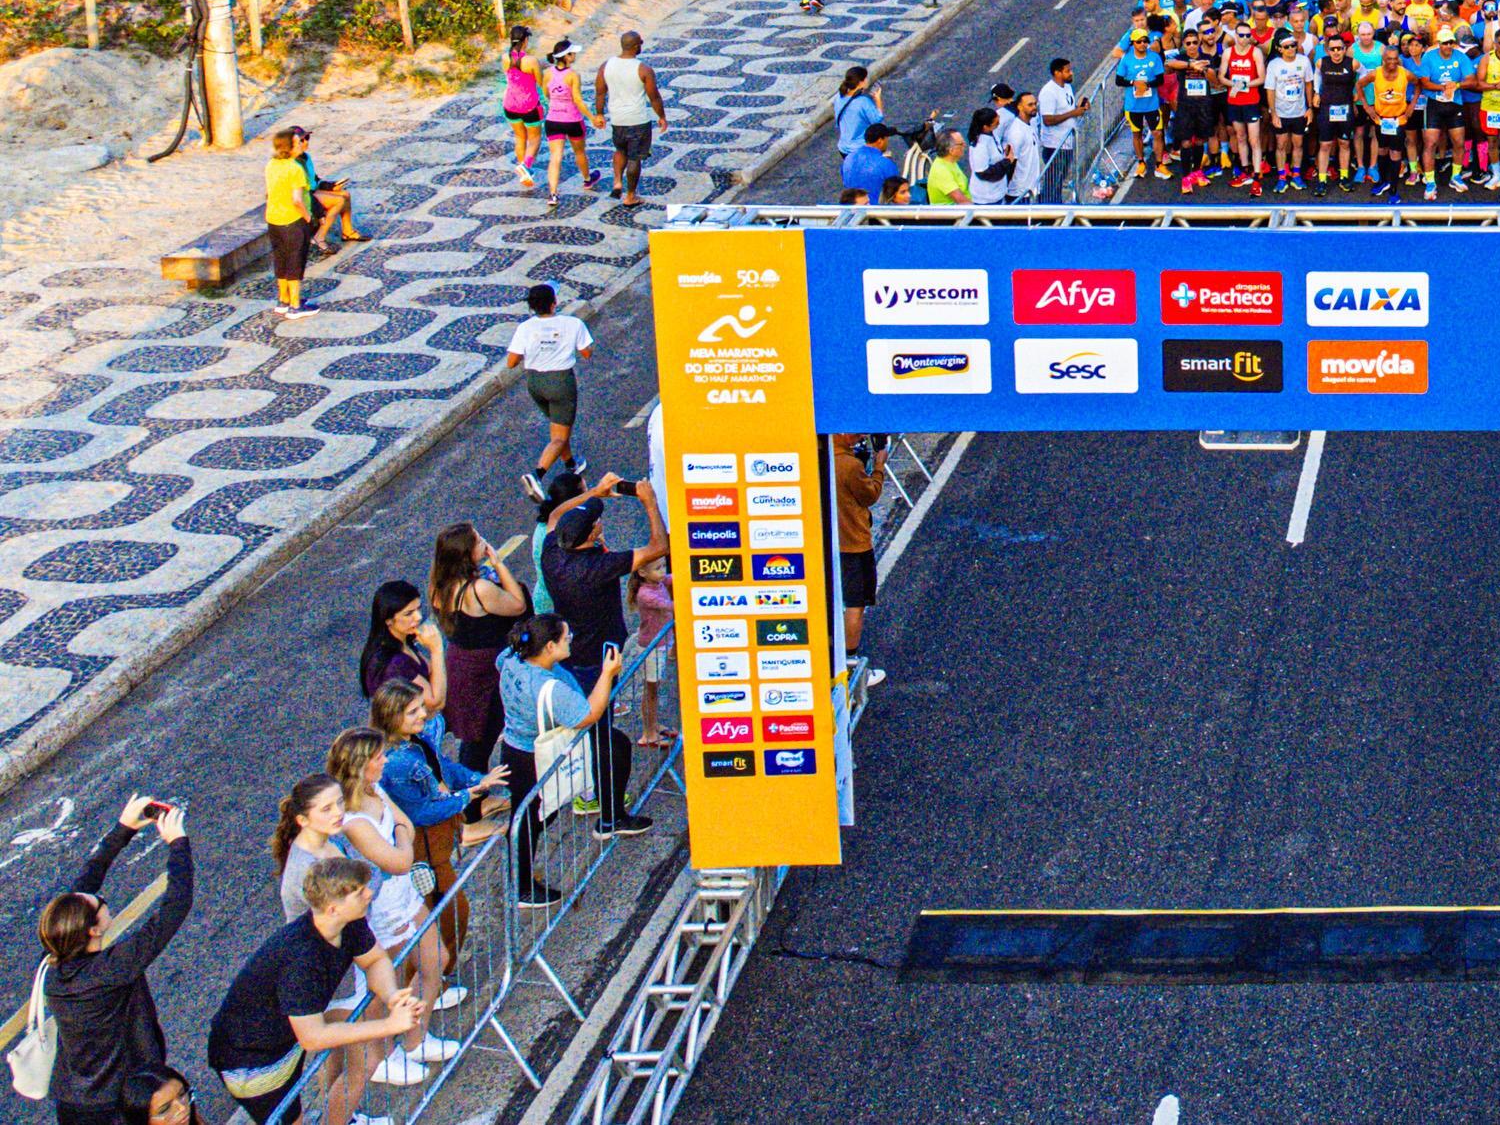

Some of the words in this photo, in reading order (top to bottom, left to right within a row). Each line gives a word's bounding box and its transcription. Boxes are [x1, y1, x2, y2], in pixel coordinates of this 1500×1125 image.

[736, 269, 760, 288] 50
[1234, 283, 1271, 292] drogarias
[903, 287, 979, 304] yescom
[1035, 279, 1116, 314] Afya
[1199, 287, 1274, 306] Pacheco
[1313, 287, 1422, 311] CAIXA
[689, 347, 716, 358] MEIA
[717, 347, 778, 358] MARATONA
[684, 362, 703, 374] DO
[703, 362, 723, 374] RIO
[724, 362, 739, 374] DE
[740, 362, 785, 374] JANEIRO
[1180, 357, 1232, 371] smart
[1234, 351, 1262, 374] fit
[1320, 349, 1415, 378] movida
[1048, 361, 1106, 380] Sesc
[706, 389, 767, 404] CAIXA
[766, 462, 793, 473] leão
[691, 494, 733, 508] movida
[752, 495, 796, 504] Cunhados
[692, 529, 737, 541] cinépolis
[698, 558, 734, 575] BALY
[698, 595, 748, 607] CAIXA
[766, 633, 798, 642] COPRA
[706, 721, 749, 739] Afya
[778, 724, 809, 733] Pacheco
[711, 759, 733, 768] smart
[733, 757, 746, 769] fit
